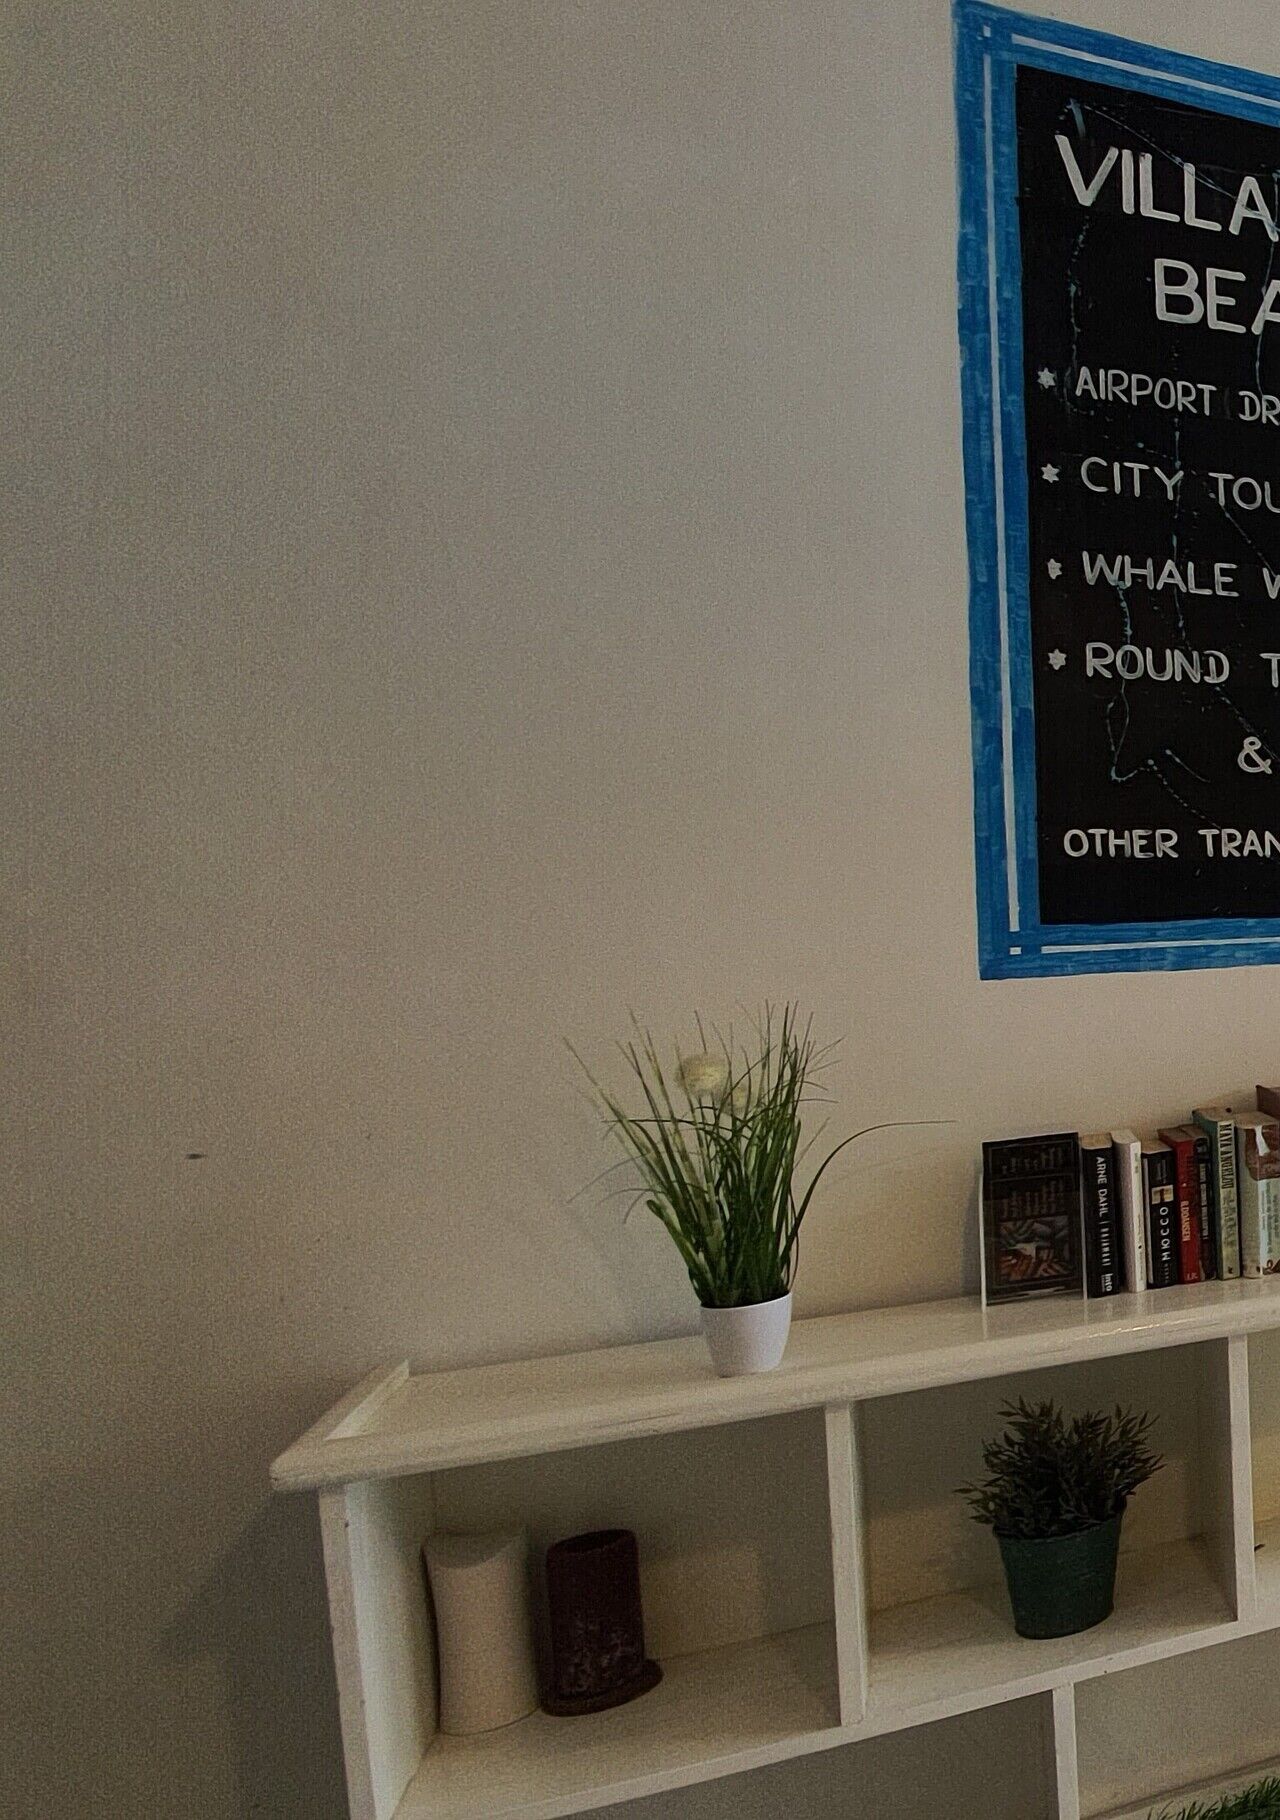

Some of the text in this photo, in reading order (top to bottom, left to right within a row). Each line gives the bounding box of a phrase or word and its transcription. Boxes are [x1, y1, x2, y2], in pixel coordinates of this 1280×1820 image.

[1055, 135, 1278, 241] VILLA
[1076, 367, 1216, 415] AIRPORT
[1081, 457, 1183, 500] CITY
[1083, 551, 1238, 596] WHALE
[1086, 643, 1229, 683] ROUND
[1238, 737, 1271, 774] &
[1064, 829, 1178, 858] OTHER
[1219, 1124, 1233, 1148] MAYA
[1096, 1157, 1108, 1184] ARNE
[1220, 1150, 1235, 1189] ANGELOU
[1097, 1189, 1109, 1217] DAHL
